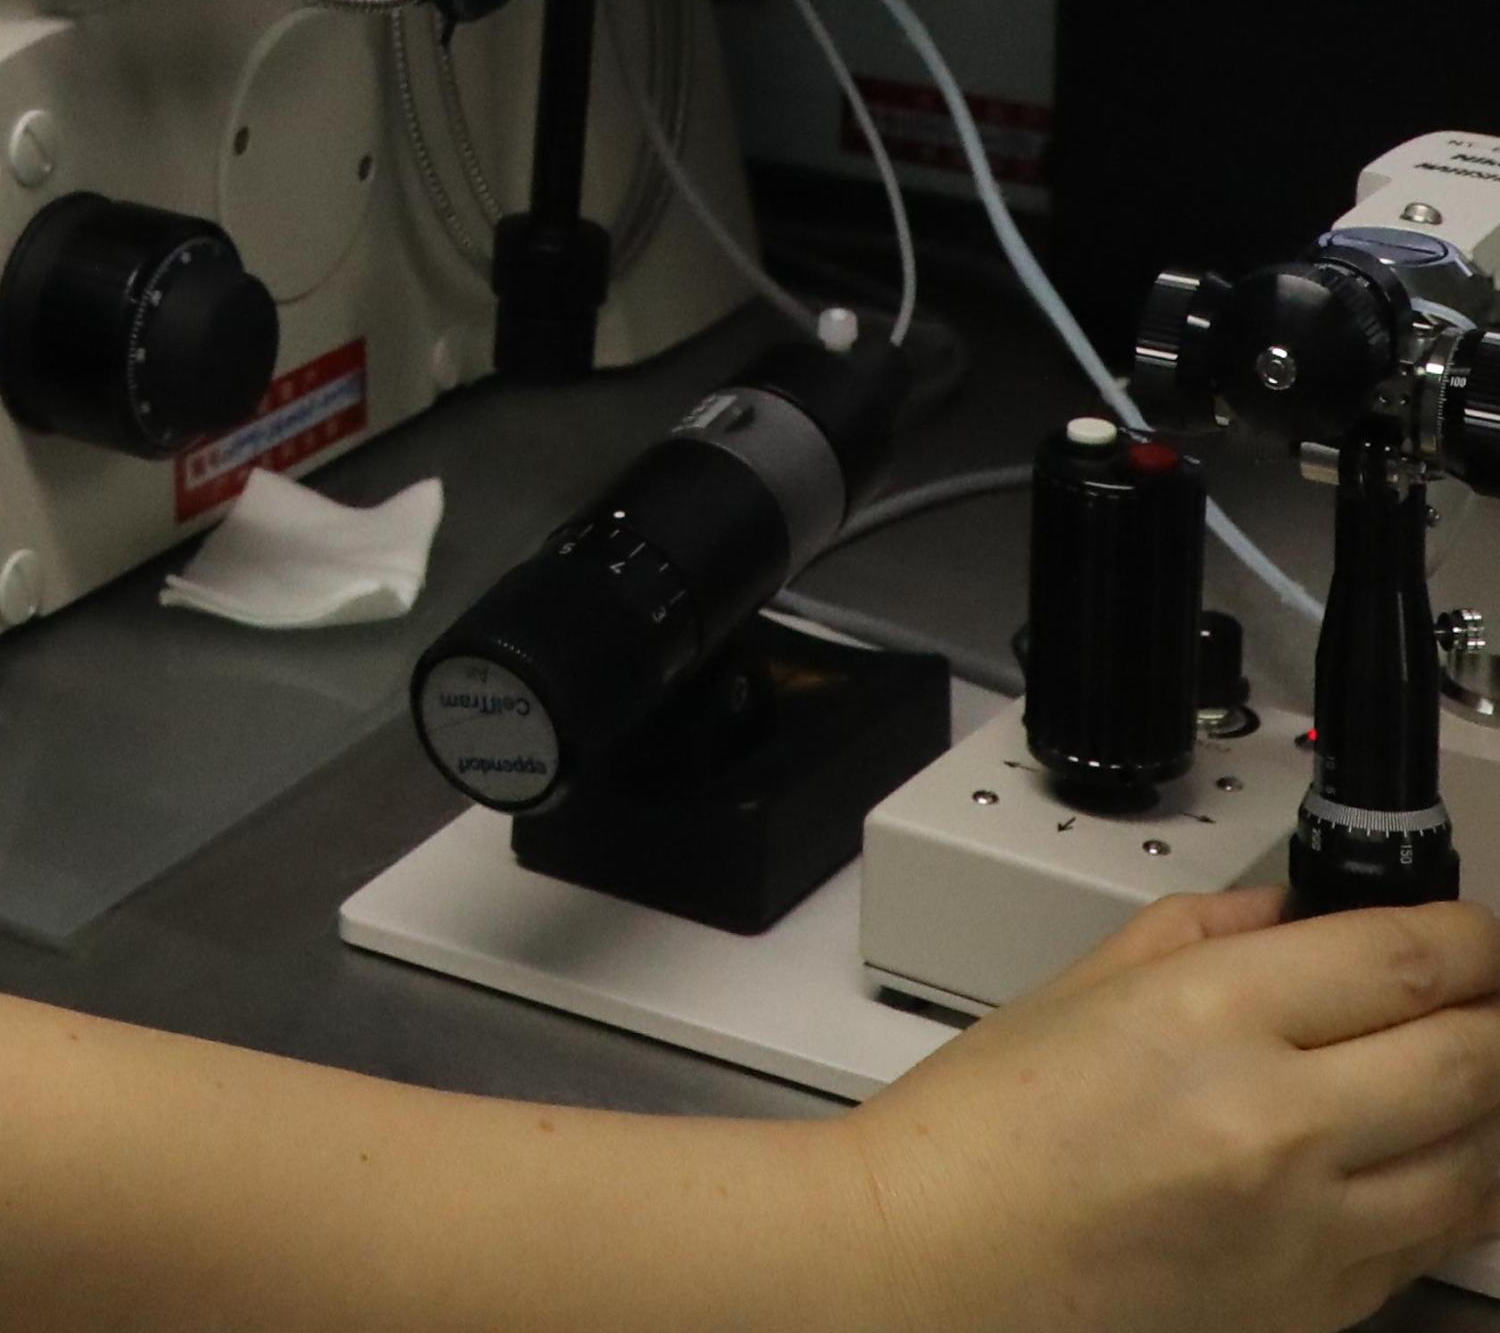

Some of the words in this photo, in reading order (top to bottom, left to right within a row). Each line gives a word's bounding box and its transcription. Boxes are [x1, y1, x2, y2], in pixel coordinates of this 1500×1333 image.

[1449, 375, 1468, 389] 100
[440, 693, 530, 716] CellTram
[458, 755, 547, 774] eppendorf
[1400, 844, 1414, 865] 150
